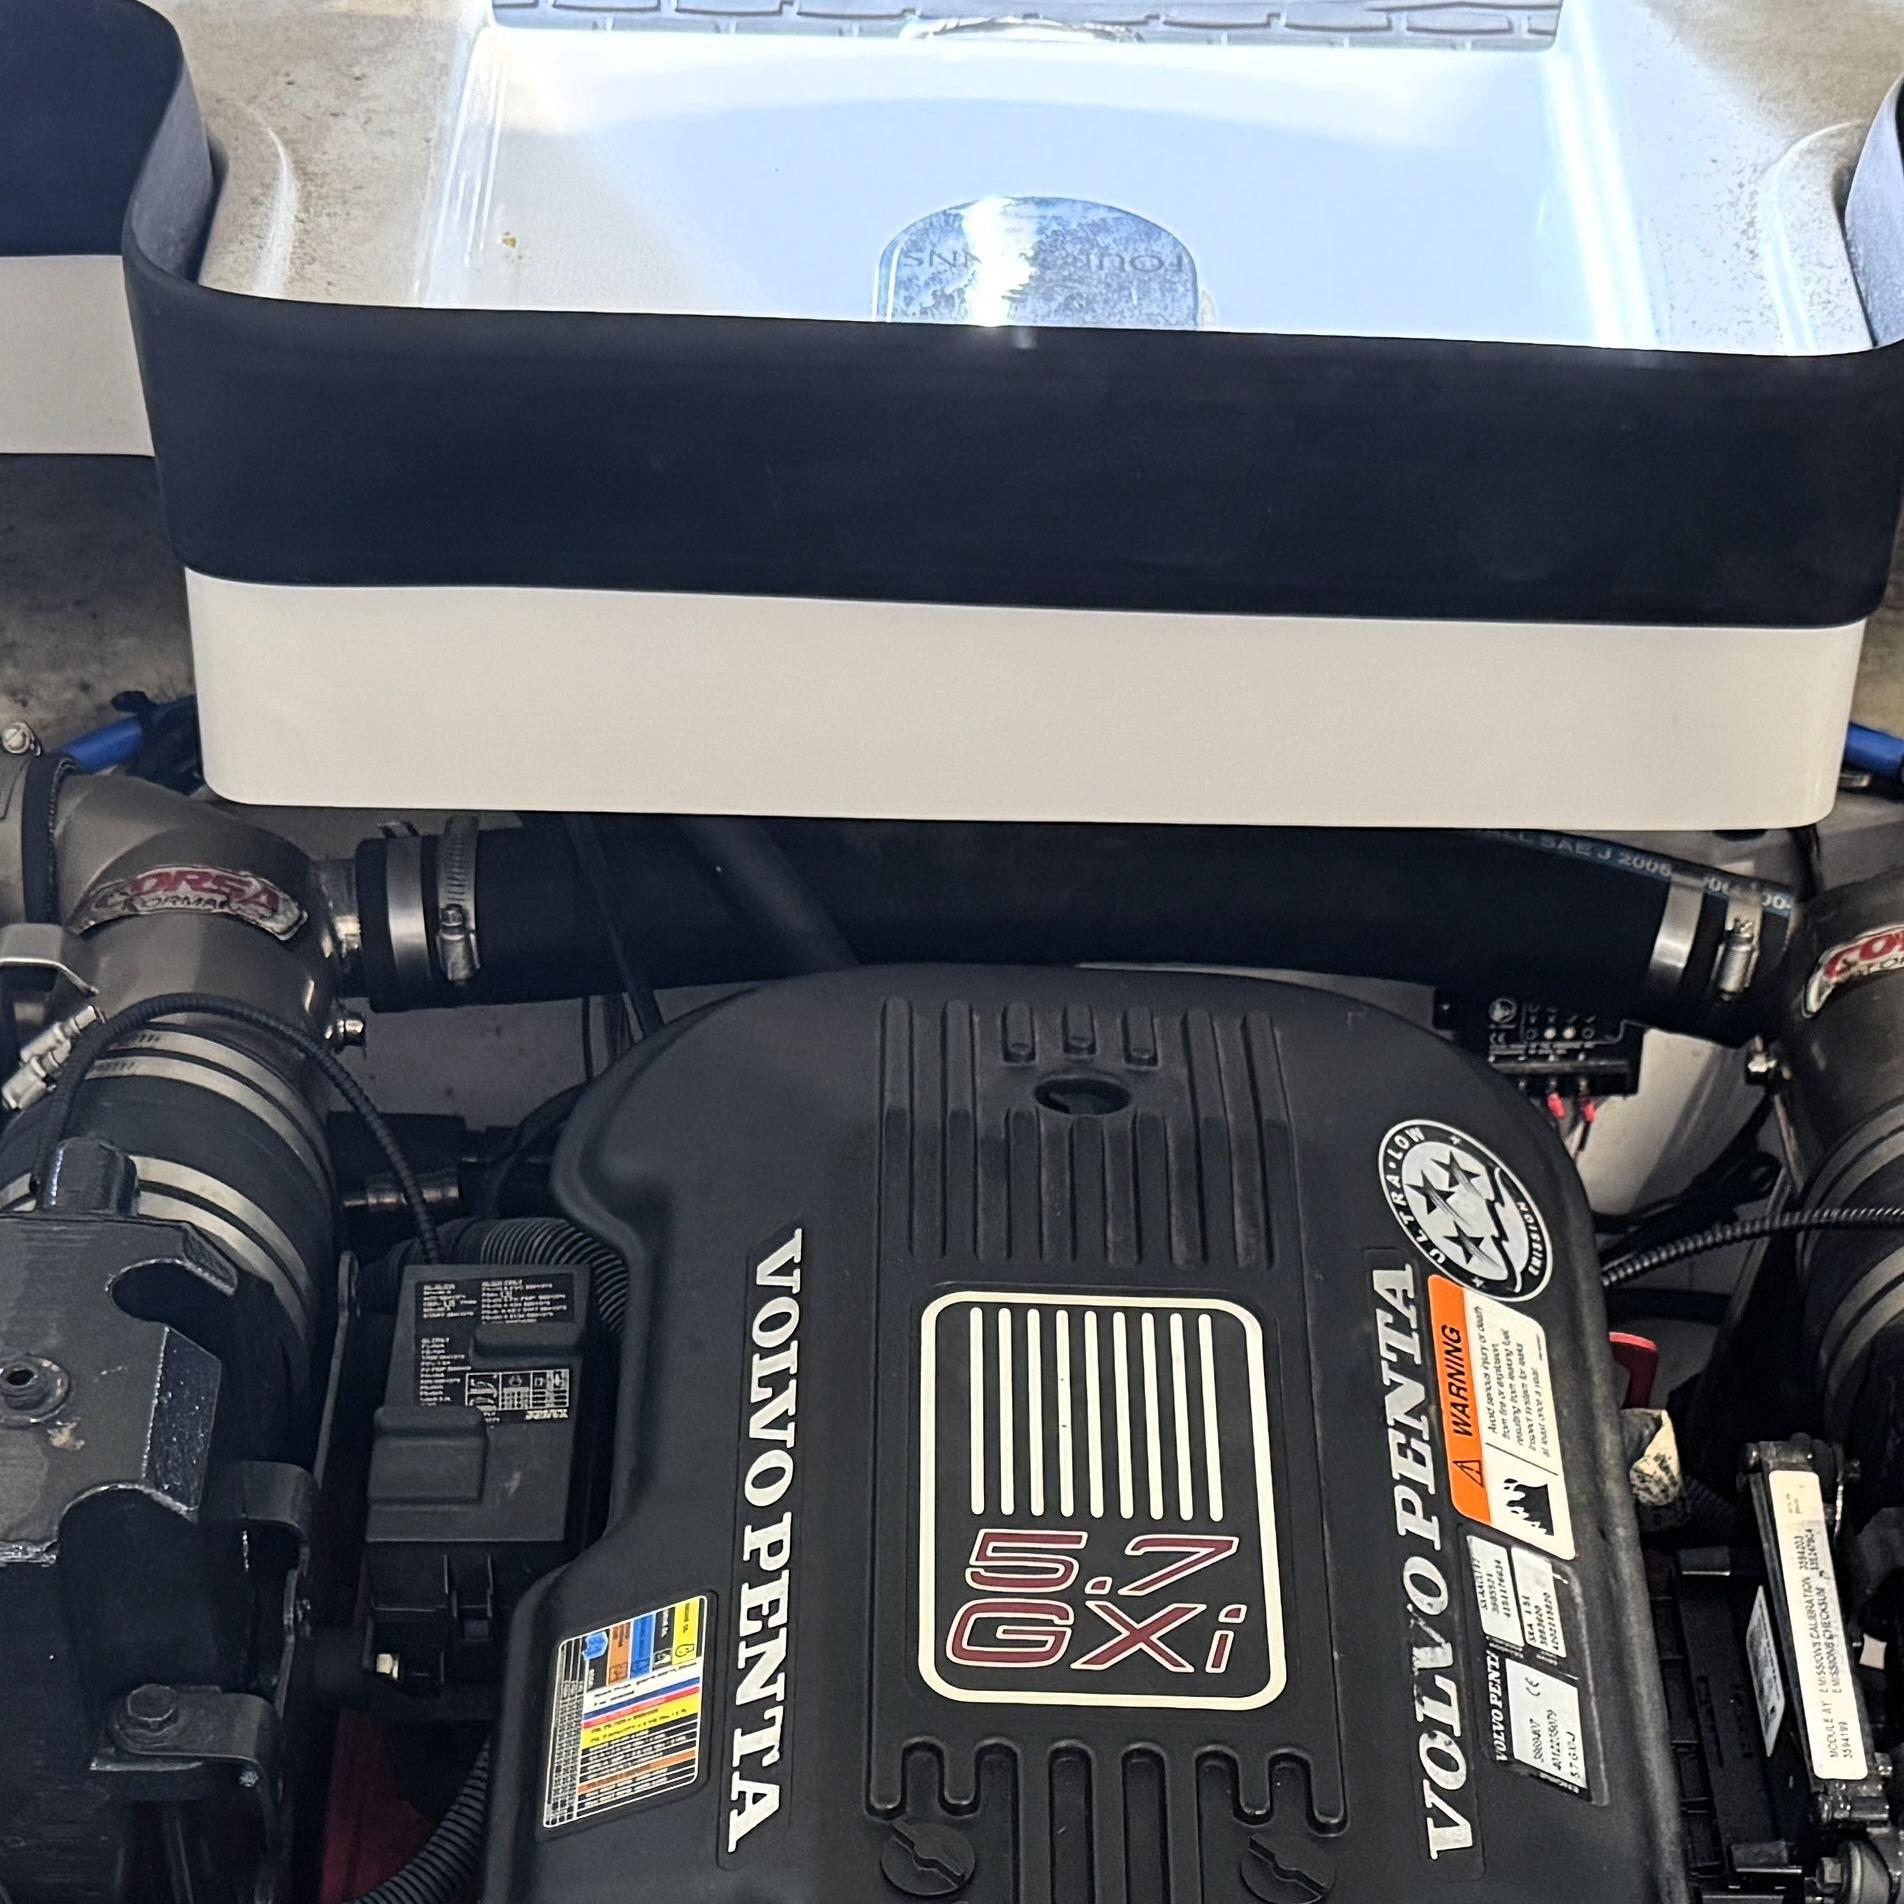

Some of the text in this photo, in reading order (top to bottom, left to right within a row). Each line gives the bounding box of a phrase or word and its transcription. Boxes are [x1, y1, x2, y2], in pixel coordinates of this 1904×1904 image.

[1515, 1200, 1545, 1277] EMISSION
[1439, 1320, 1473, 1440] WARNING
[1484, 1405, 1497, 1434] Avoid
[728, 1228, 805, 1853] VOLVO PENTA
[964, 1529, 1241, 1597] 5.7
[1372, 1263, 1471, 1860] VOLVO PENTA
[944, 1602, 1248, 1676] GXi
[1490, 1706, 1508, 1764] VOLVO
